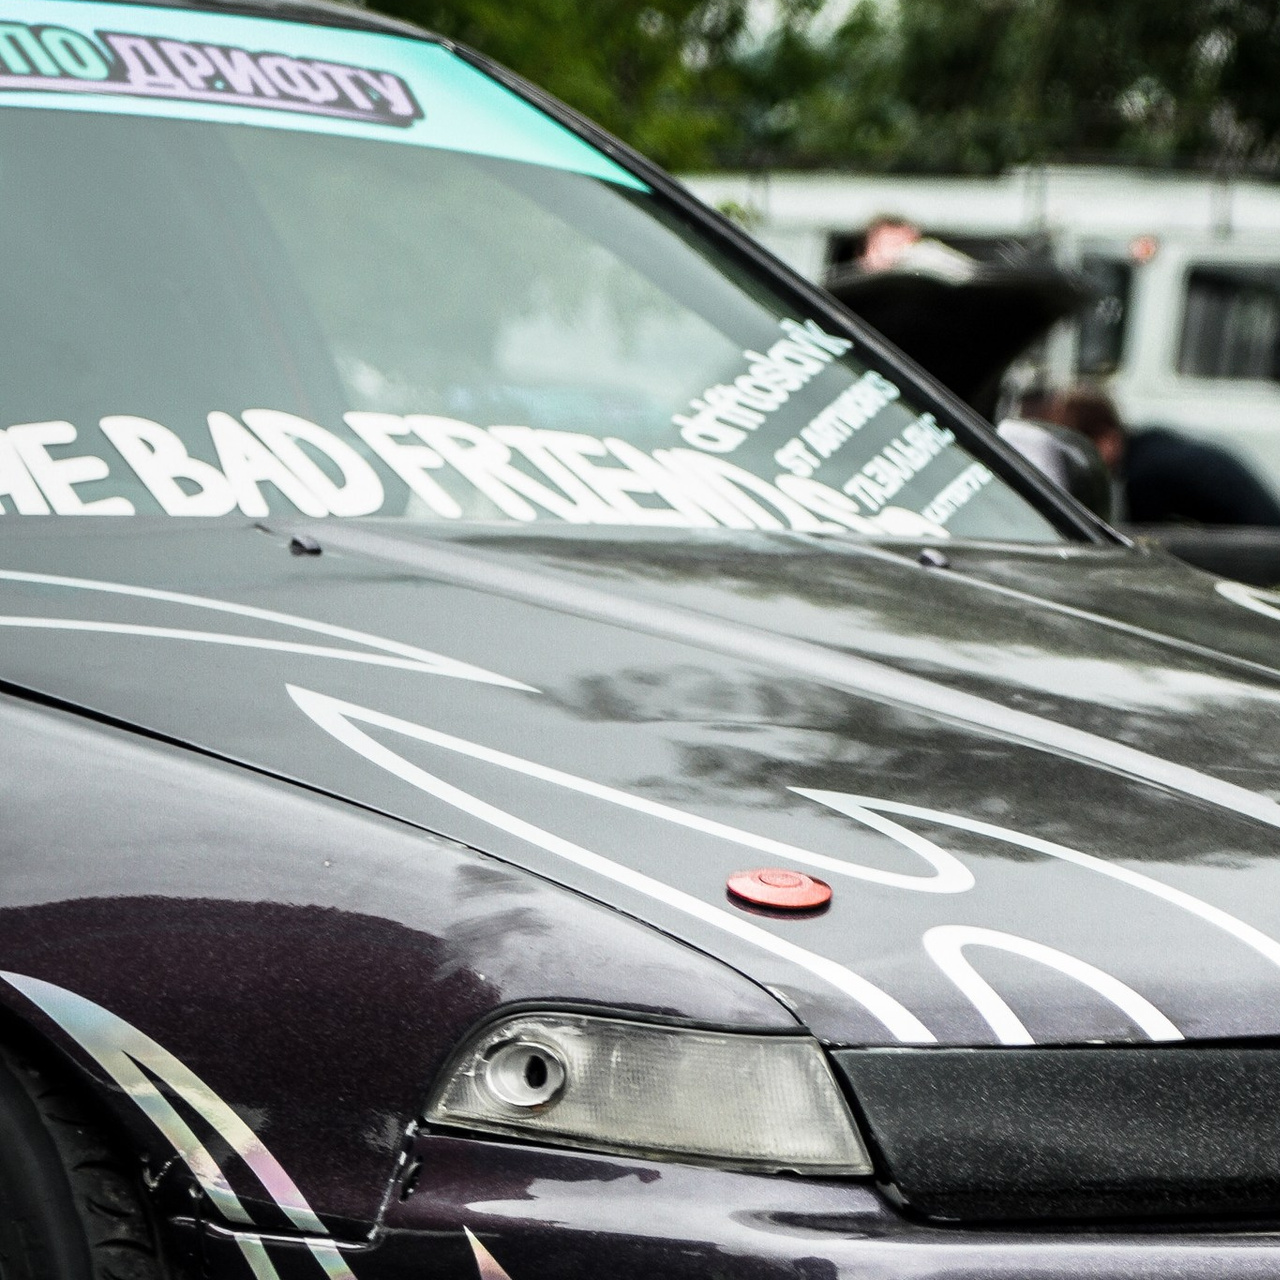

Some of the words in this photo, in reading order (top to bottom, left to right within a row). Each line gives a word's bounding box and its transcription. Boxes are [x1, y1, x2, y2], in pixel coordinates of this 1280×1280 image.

[105, 34, 415, 117] ДРИФТУ
[99, 408, 384, 517] BAD
[774, 438, 820, 477] ST
